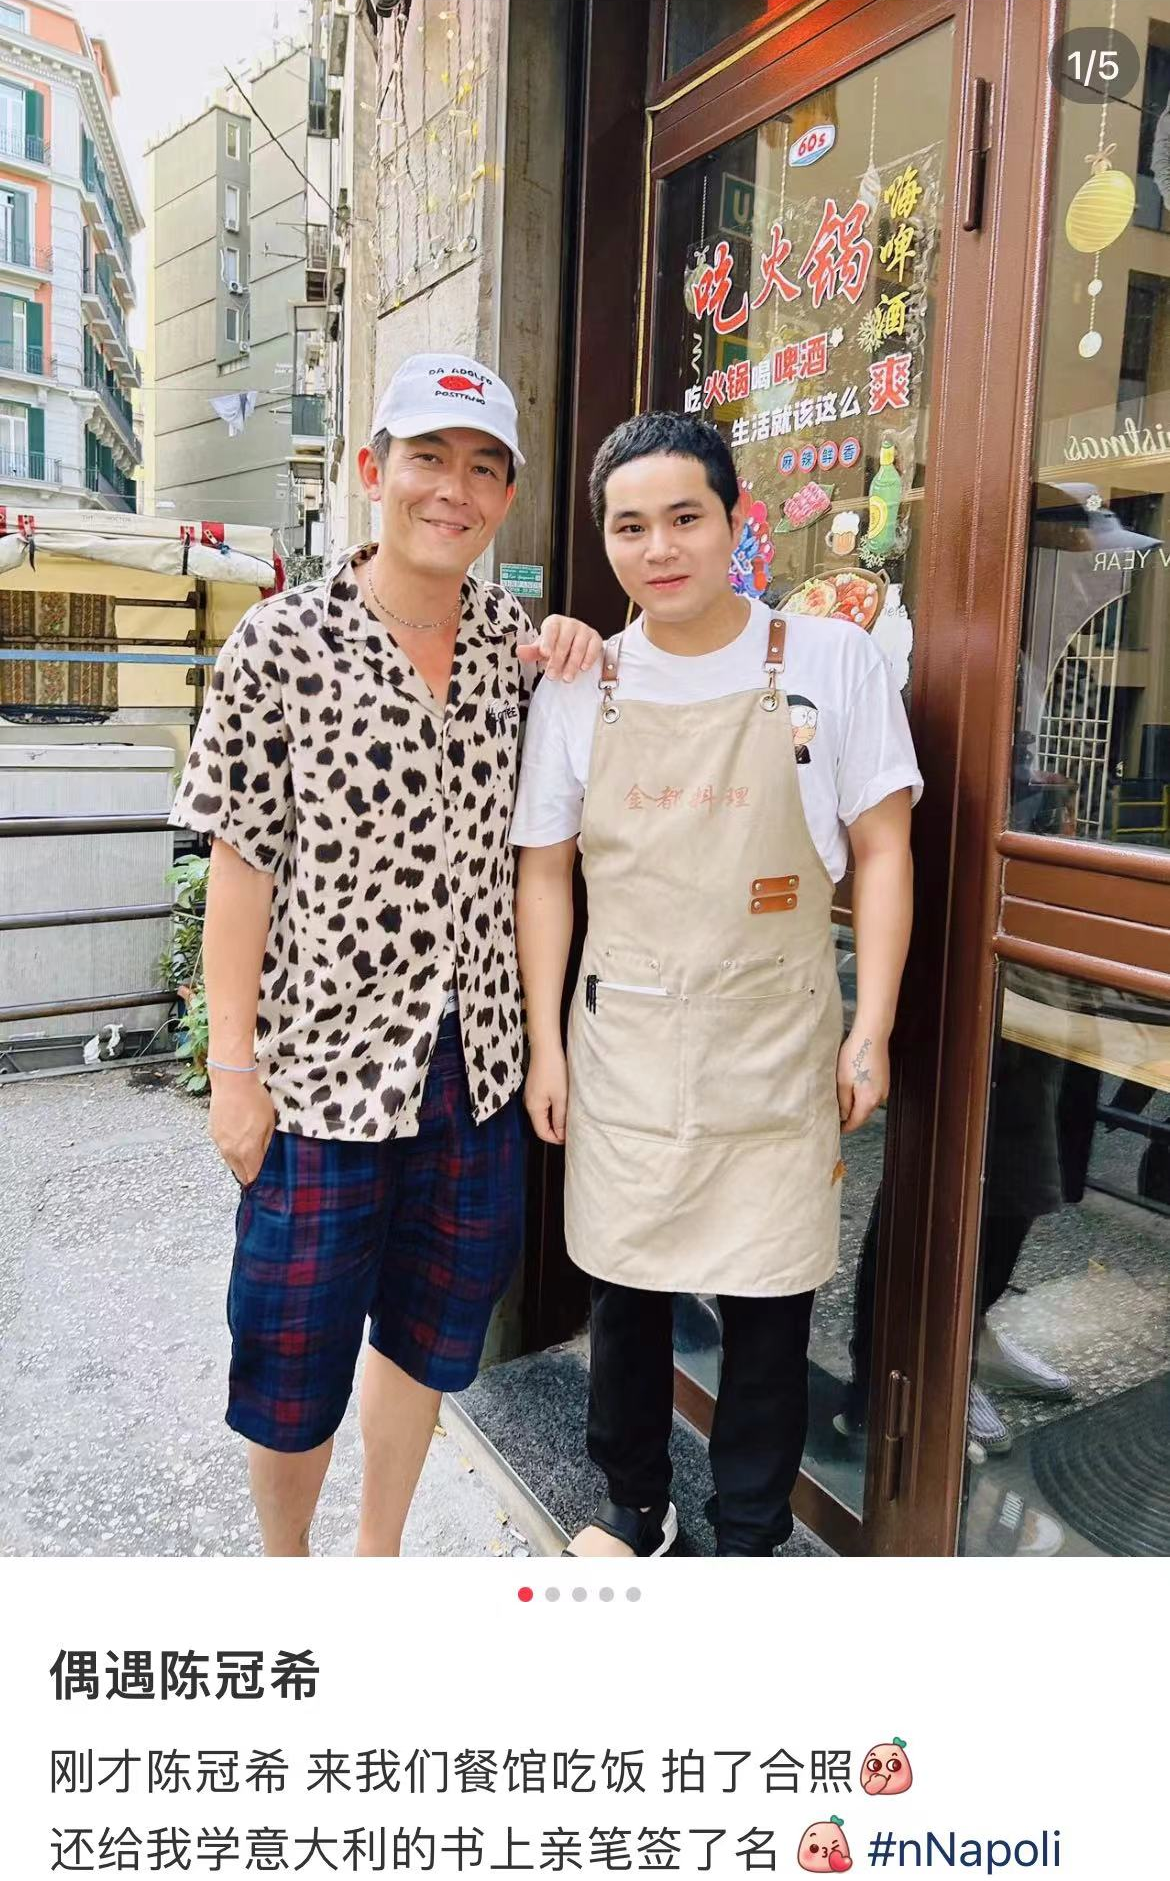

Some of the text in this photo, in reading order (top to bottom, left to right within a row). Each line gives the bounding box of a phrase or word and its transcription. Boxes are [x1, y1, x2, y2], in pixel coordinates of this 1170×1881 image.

[796, 130, 827, 159] 60s
[693, 198, 873, 336] 吃火锅
[873, 165, 923, 339] 嗨啤酒
[428, 367, 493, 386] DA ADOLFO
[684, 332, 829, 412] 吃火锅喝啤酒
[623, 783, 751, 817] 金都料理
